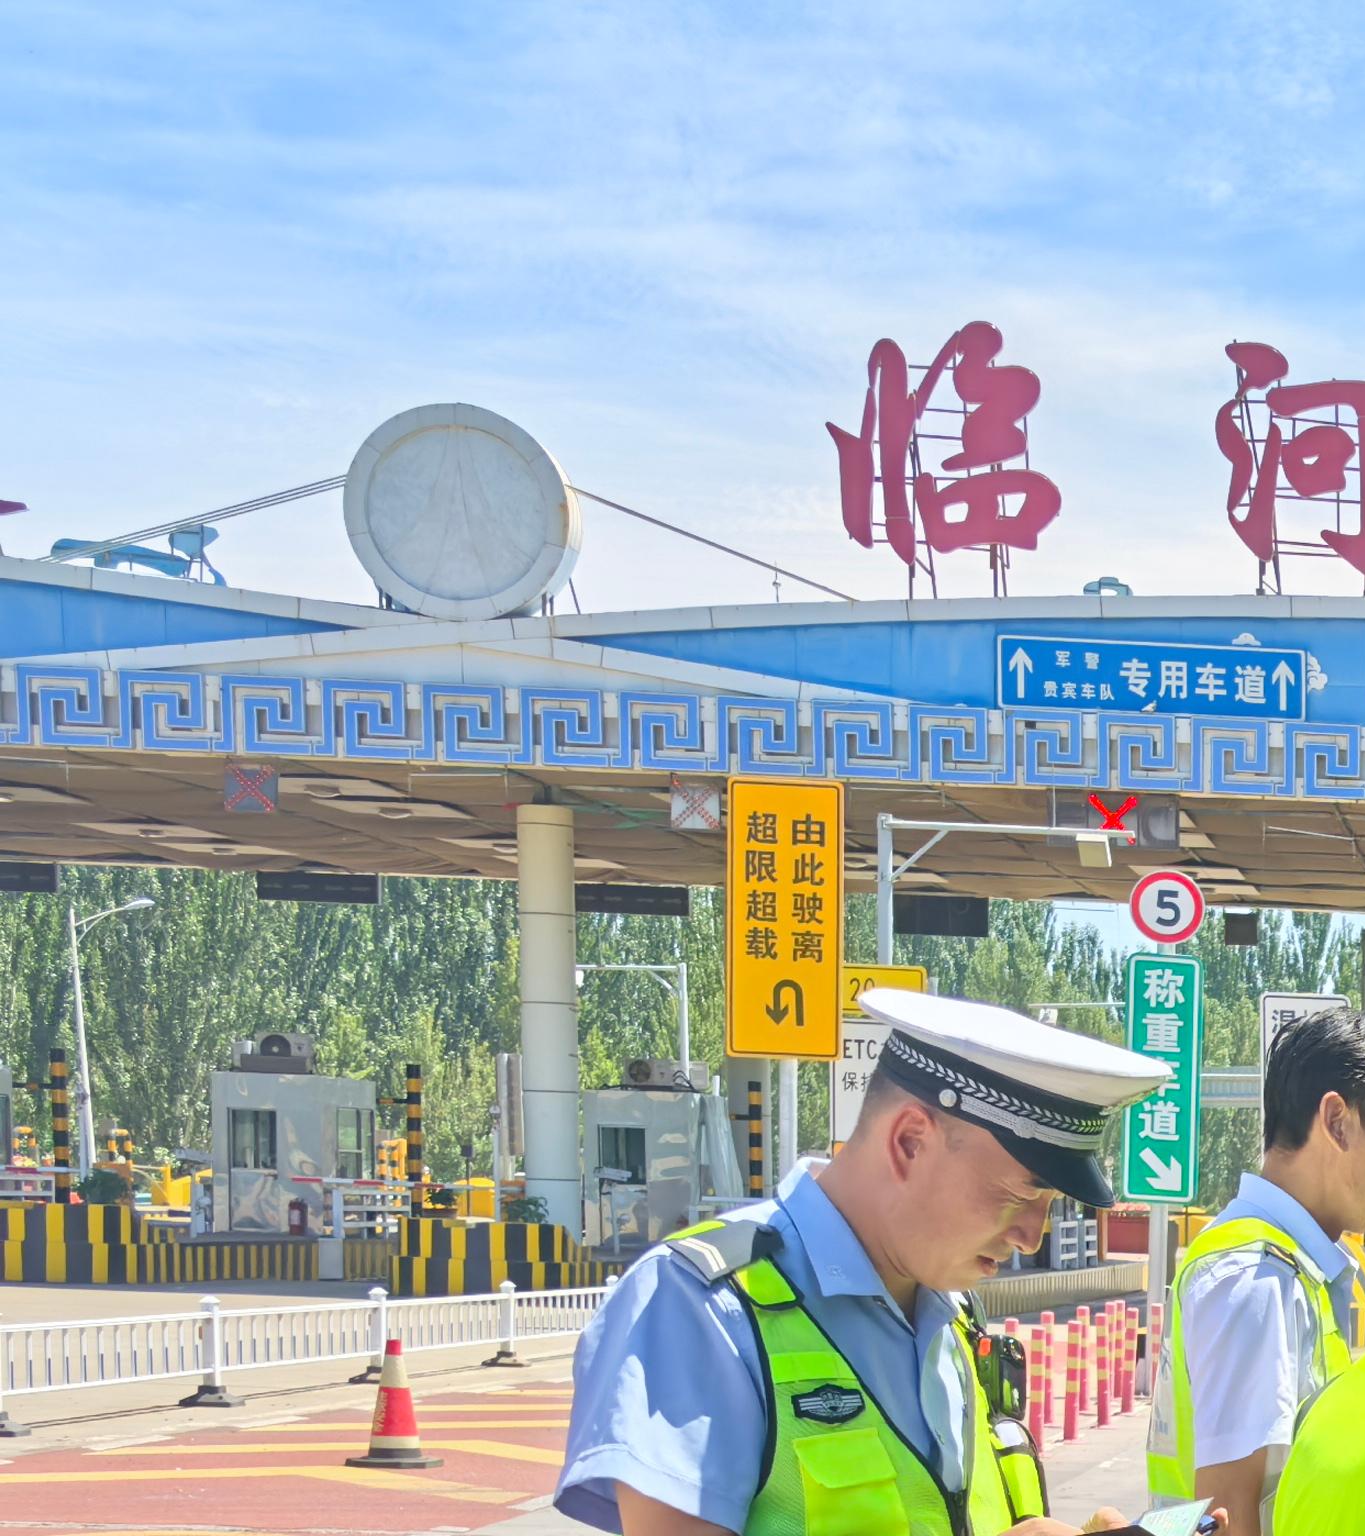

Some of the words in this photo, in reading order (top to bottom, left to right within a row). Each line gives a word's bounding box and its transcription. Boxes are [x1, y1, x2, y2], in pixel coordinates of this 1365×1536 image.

[1055, 650, 1100, 670] 军警
[1043, 680, 1116, 701] 贵宾车队
[1119, 657, 1267, 705] 专用车道
[744, 811, 779, 961] 超限超载
[791, 813, 827, 964] 由此驶离
[1155, 889, 1180, 928] 5
[843, 1039, 885, 1060] ETC
